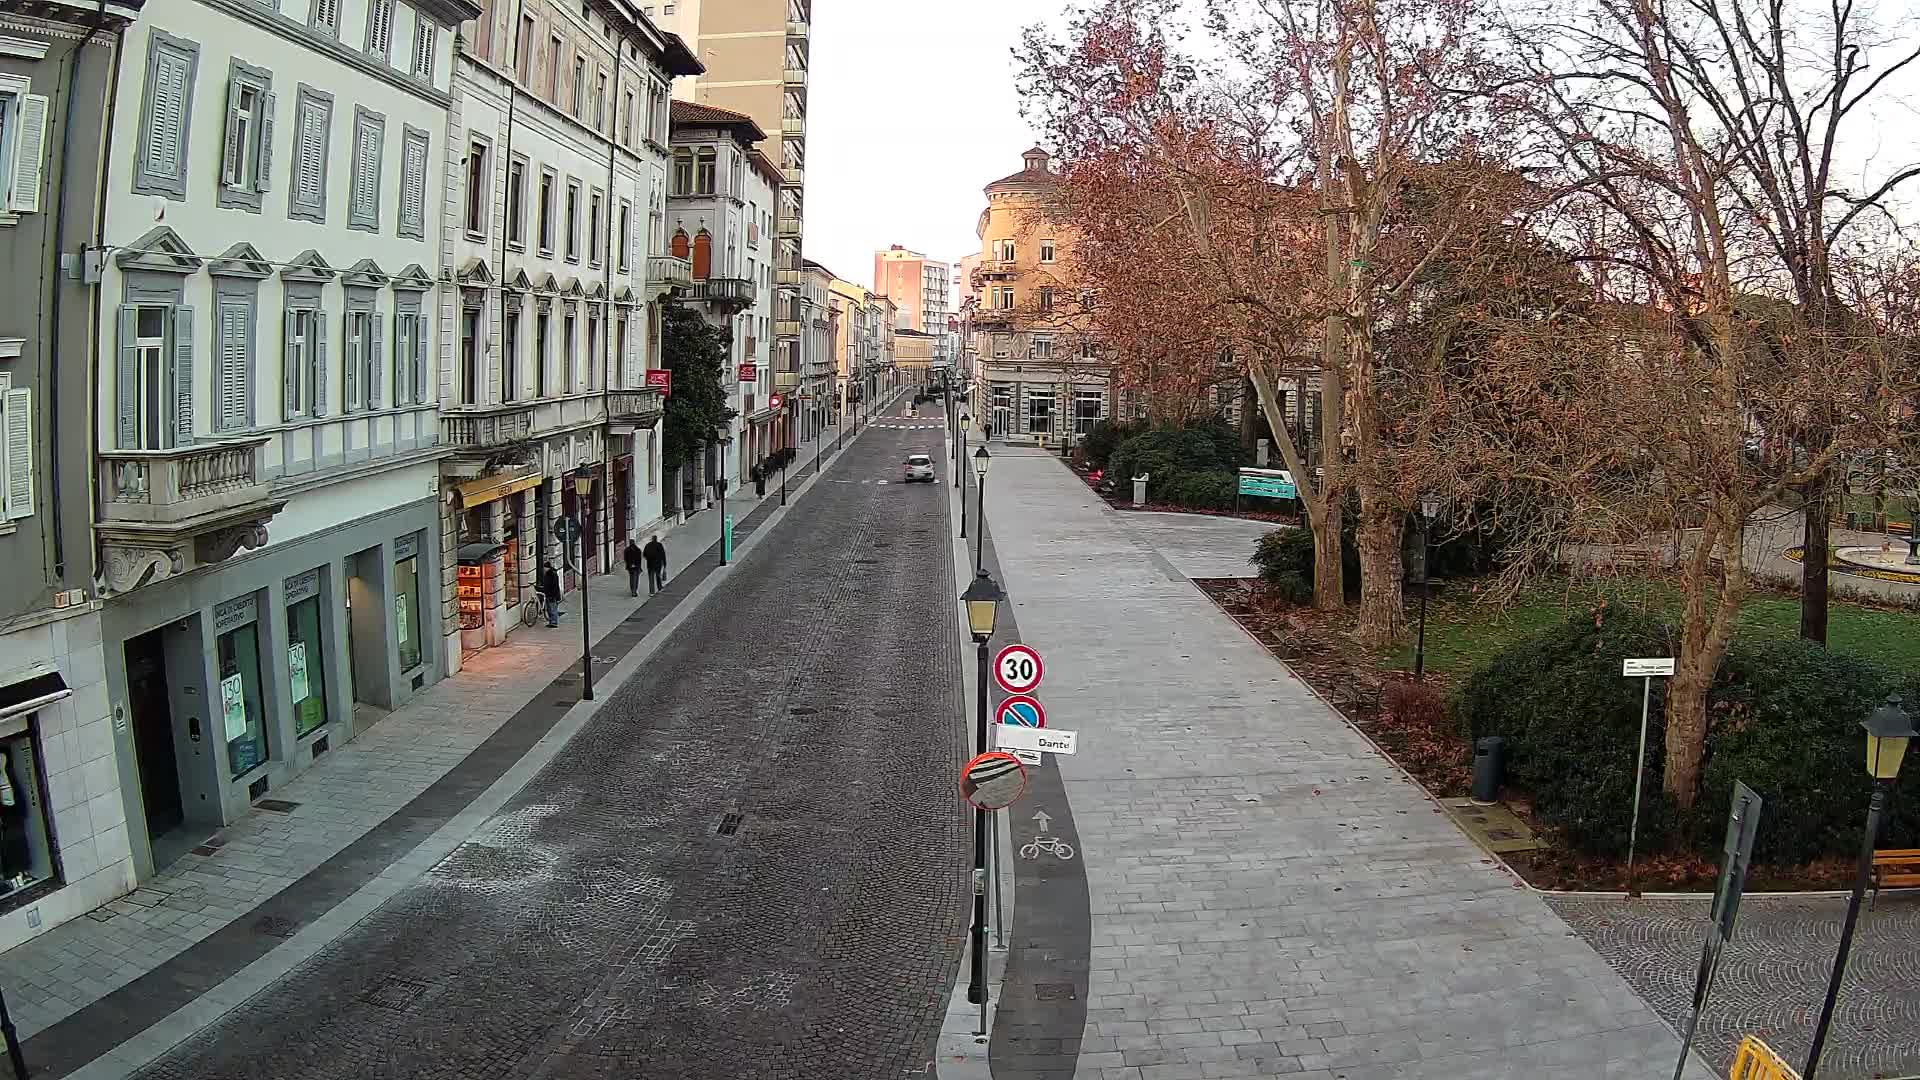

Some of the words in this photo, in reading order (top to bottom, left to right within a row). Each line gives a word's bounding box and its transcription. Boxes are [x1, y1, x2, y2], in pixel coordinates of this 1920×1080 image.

[233, 598, 255, 611] CREDITO
[289, 645, 304, 666] 130
[1005, 659, 1033, 680] 30
[223, 677, 241, 700] 130
[1039, 738, 1070, 749] Dante
